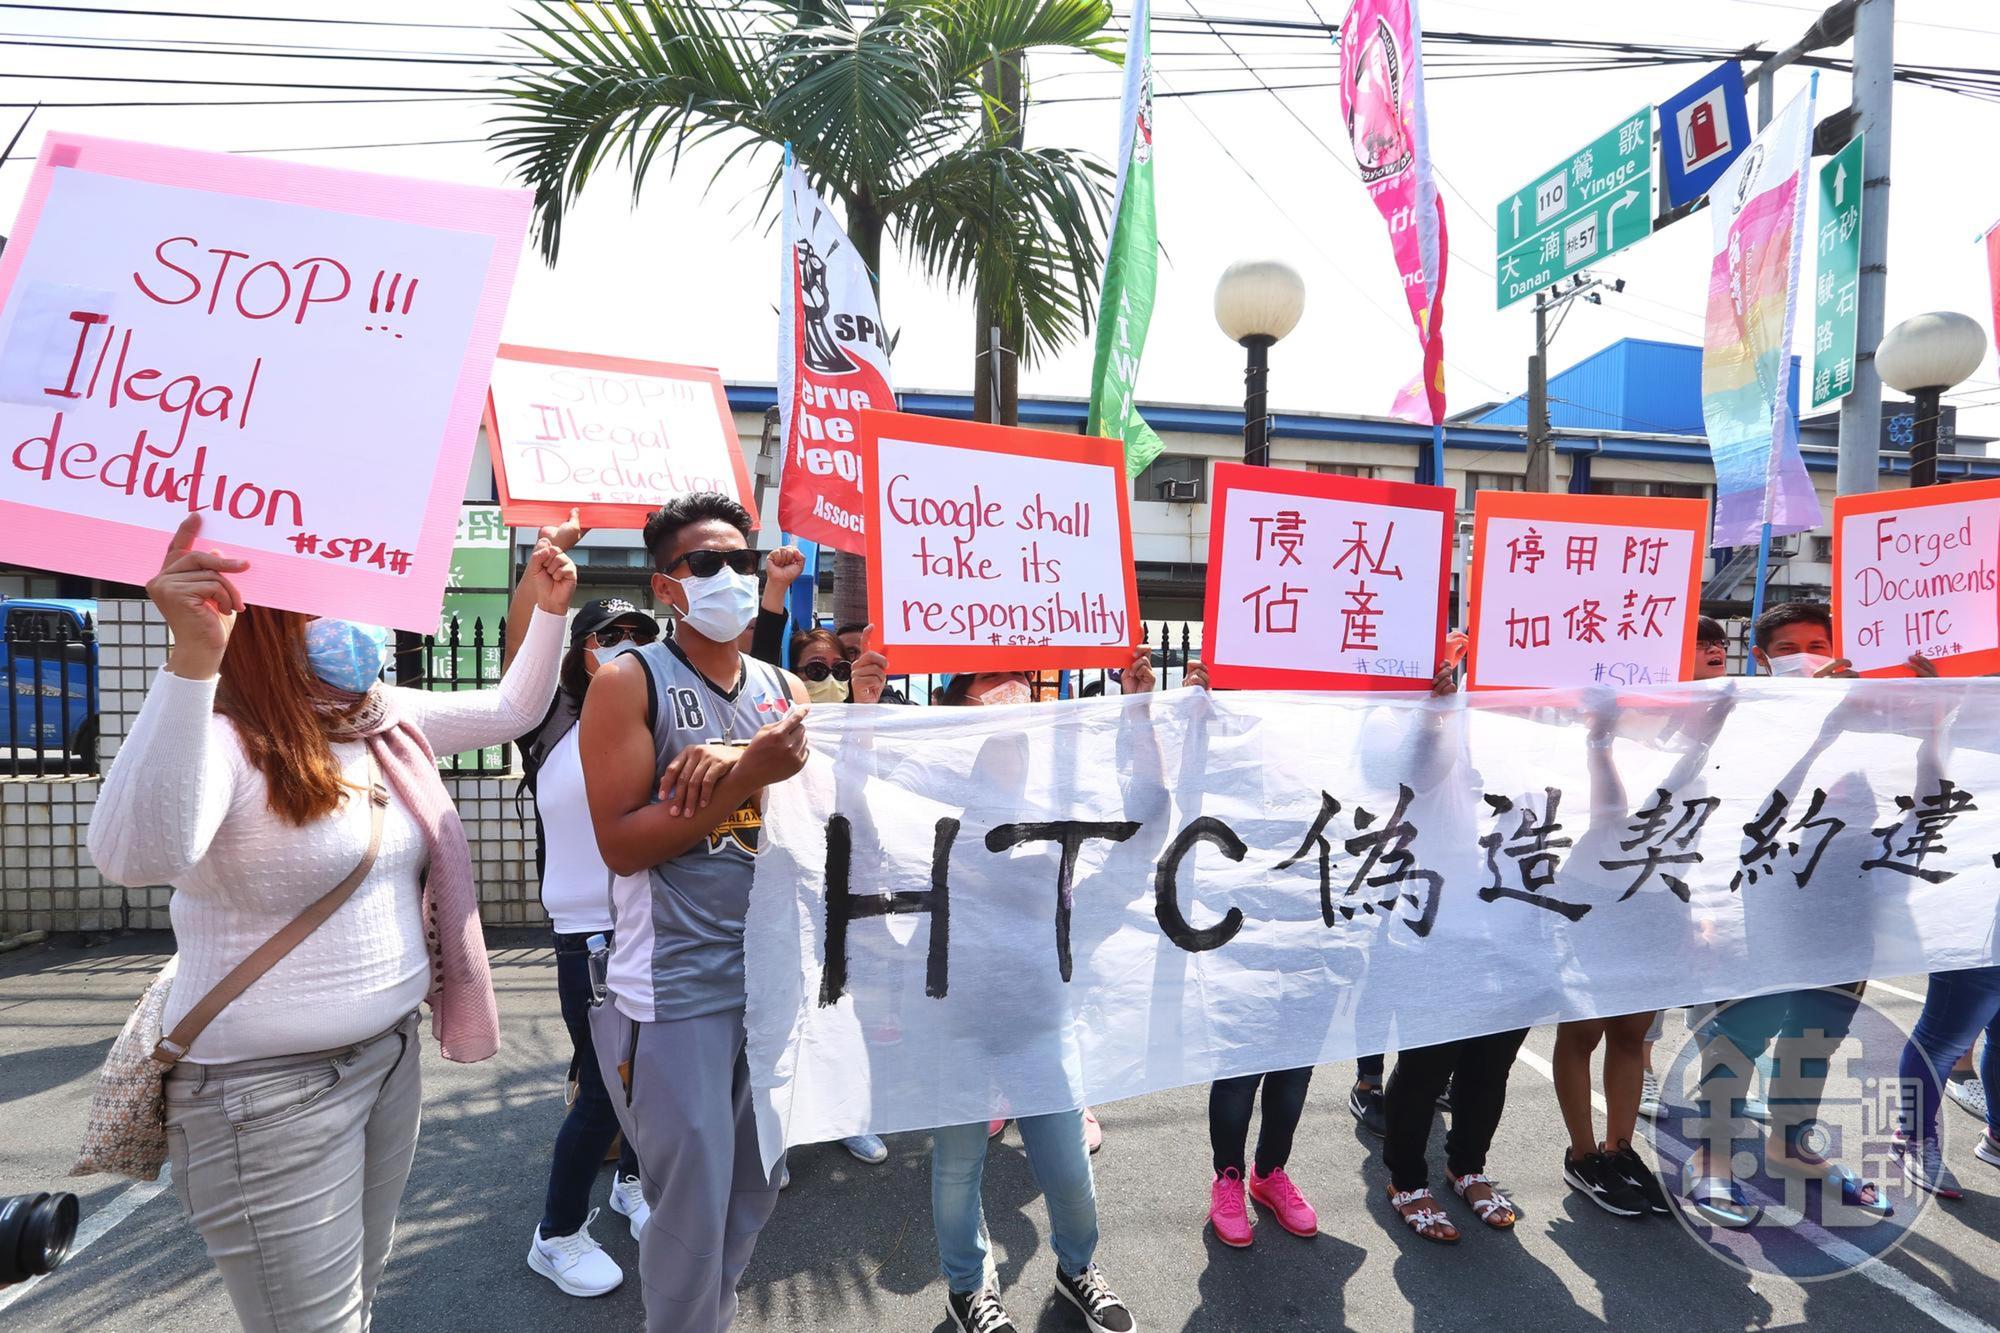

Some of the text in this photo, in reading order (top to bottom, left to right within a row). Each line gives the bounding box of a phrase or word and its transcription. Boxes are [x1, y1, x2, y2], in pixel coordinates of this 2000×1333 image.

[1572, 117, 1645, 187] 鶯歌
[1539, 185, 1563, 211] 110
[1580, 159, 1636, 201] Yingge
[133, 236, 351, 324] STOP
[1509, 269, 1551, 299] Danan
[1833, 205, 1858, 391] 砂石車
[1815, 218, 1838, 402] 行駛路線
[44, 311, 261, 457] Illegal
[550, 369, 664, 407] STOP
[801, 377, 872, 411] erve
[530, 403, 670, 461] Illegal
[798, 402, 855, 443] he
[12, 412, 303, 527] deduction
[521, 446, 729, 496] Deduction
[812, 494, 865, 535] Associ
[887, 474, 1090, 543] Google shall
[286, 531, 413, 575] #SPA#
[912, 536, 1061, 583] take its
[1876, 516, 1972, 567] Forged
[1855, 559, 1996, 607] Documents
[902, 592, 1125, 645] responsibility
[1905, 609, 1952, 646] HTC
[666, 686, 706, 731] 18
[1271, 779, 2000, 939] 偽造契約違
[817, 812, 1248, 1008] HTC
